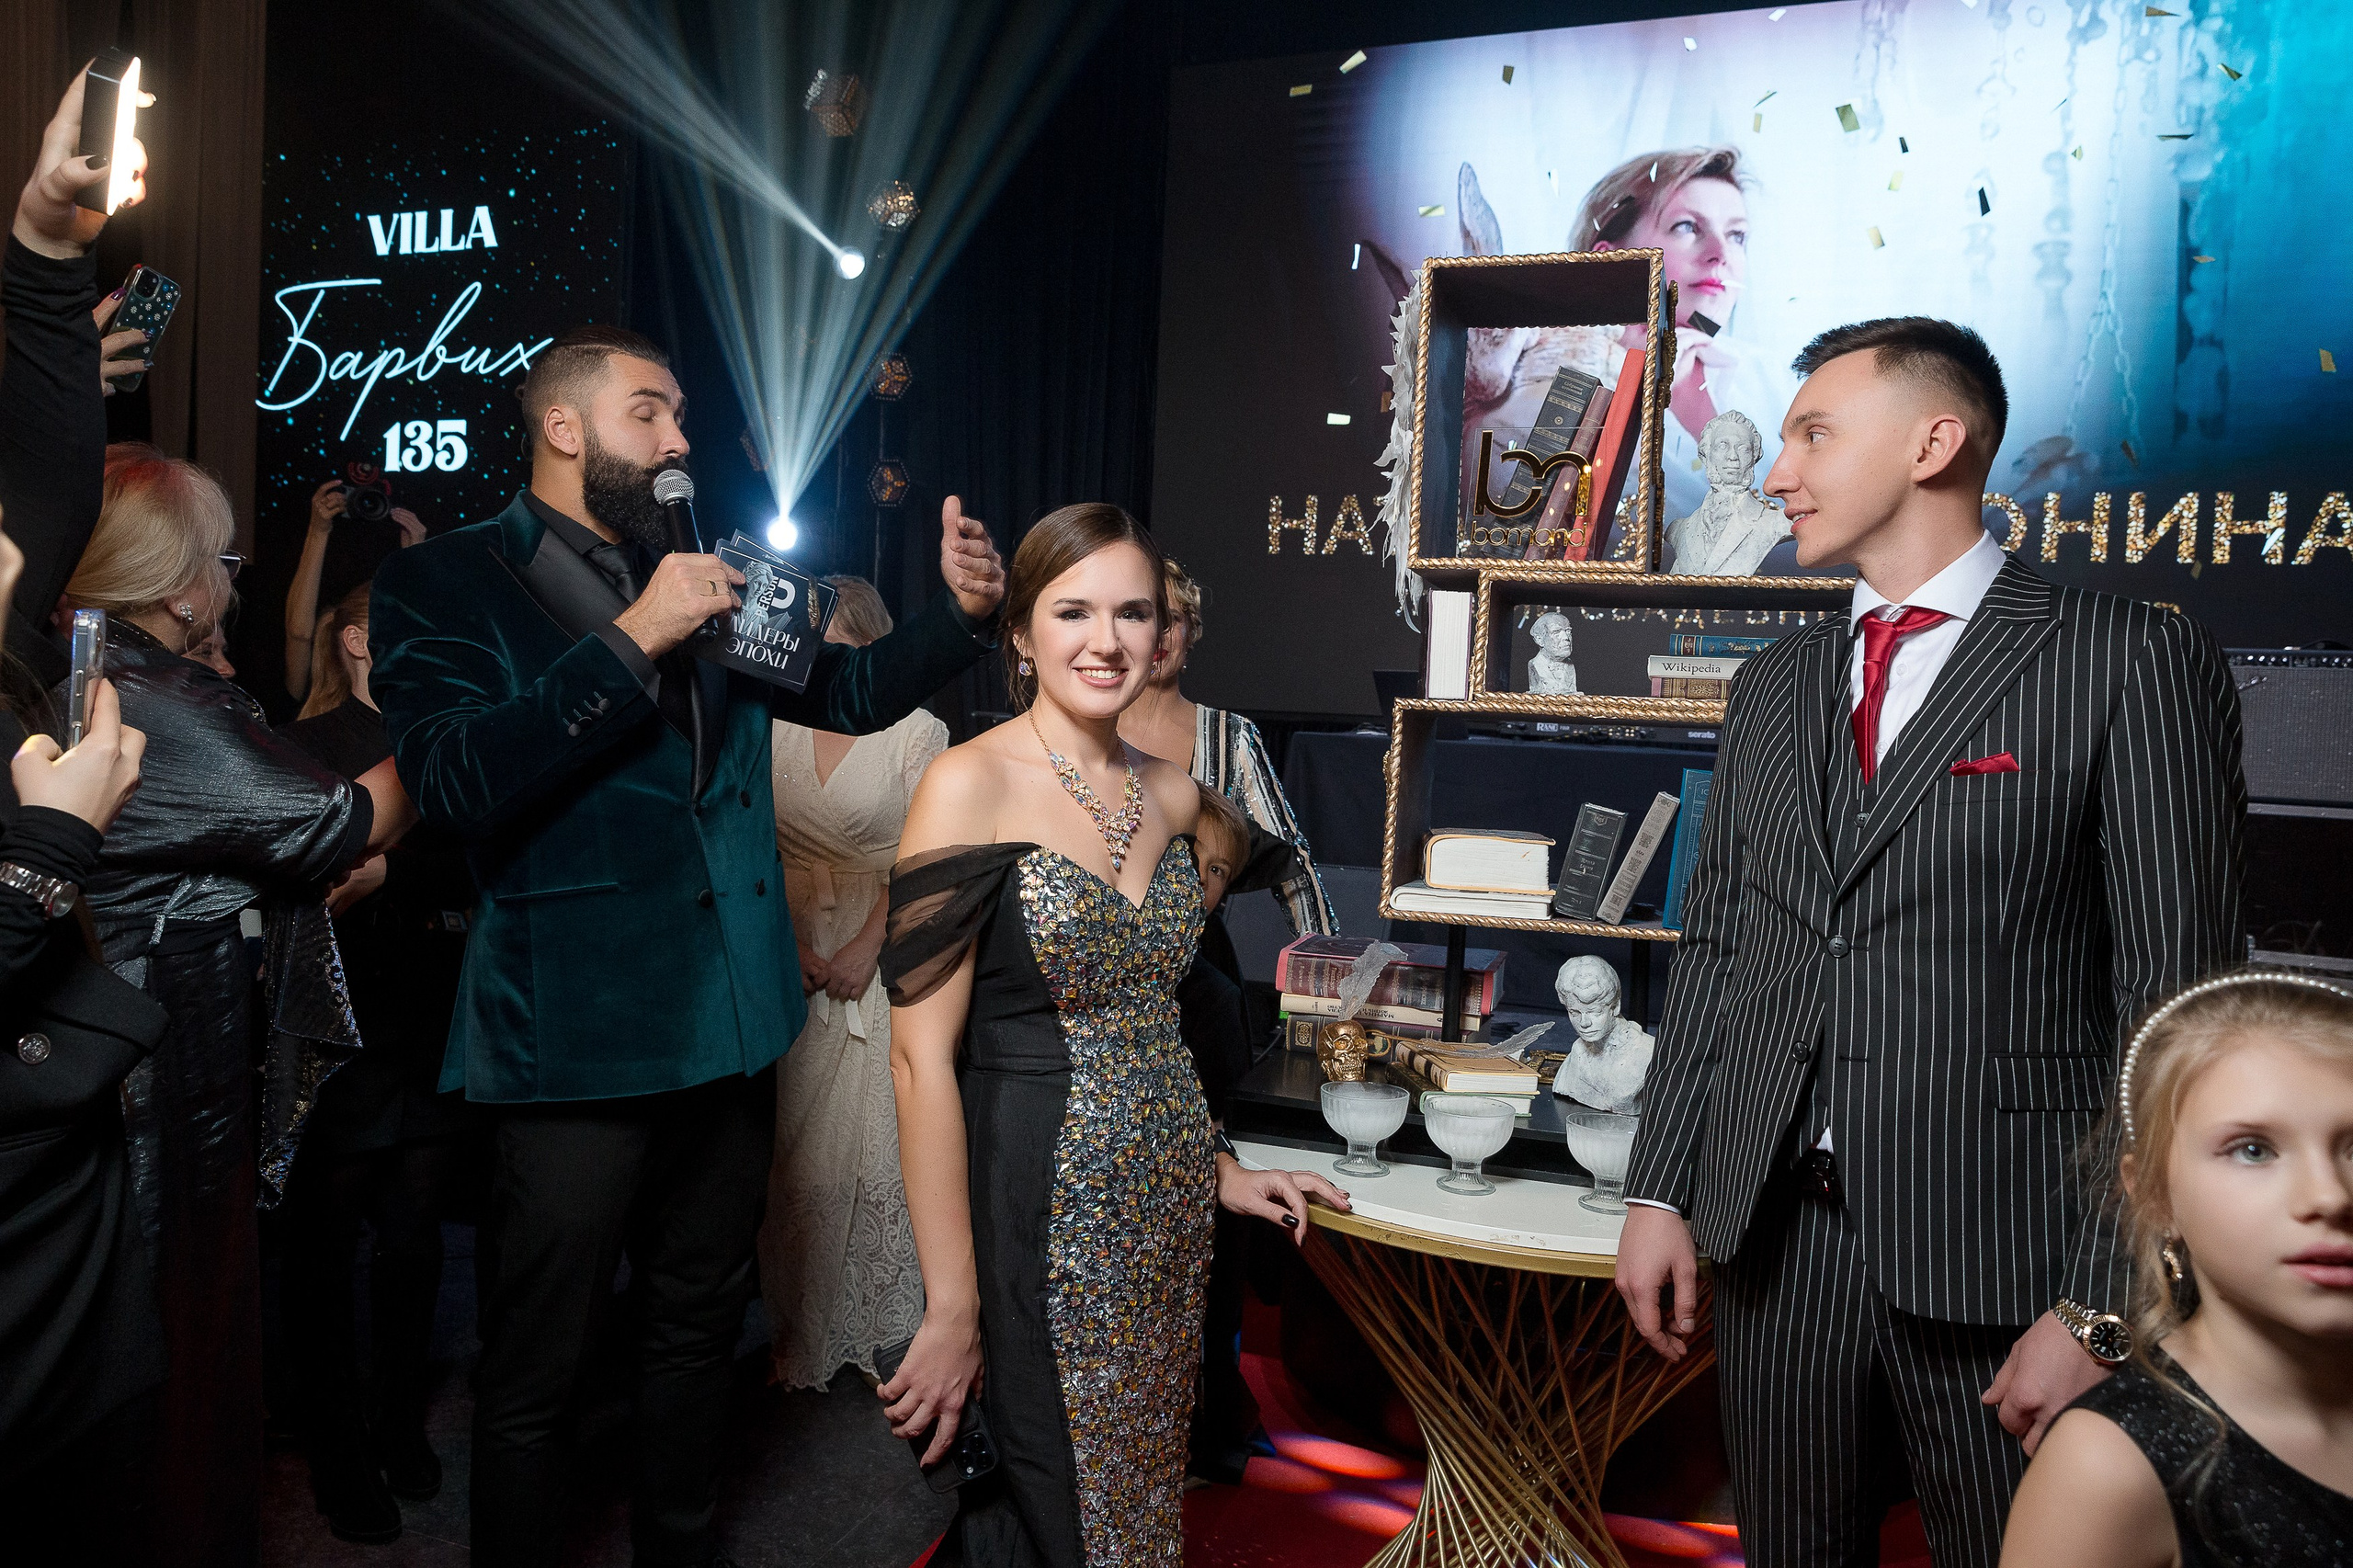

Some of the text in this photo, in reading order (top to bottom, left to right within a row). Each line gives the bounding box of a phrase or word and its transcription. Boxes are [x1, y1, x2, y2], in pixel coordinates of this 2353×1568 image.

[367, 205, 498, 256] VILLA
[382, 419, 469, 472] 135
[1471, 520, 1588, 547] bomond
[731, 615, 801, 653] ЛИДЕРЫ
[725, 636, 790, 670] ЭПОХИ
[1661, 662, 1722, 676] Wikipedia
[1688, 731, 1716, 739] serato
